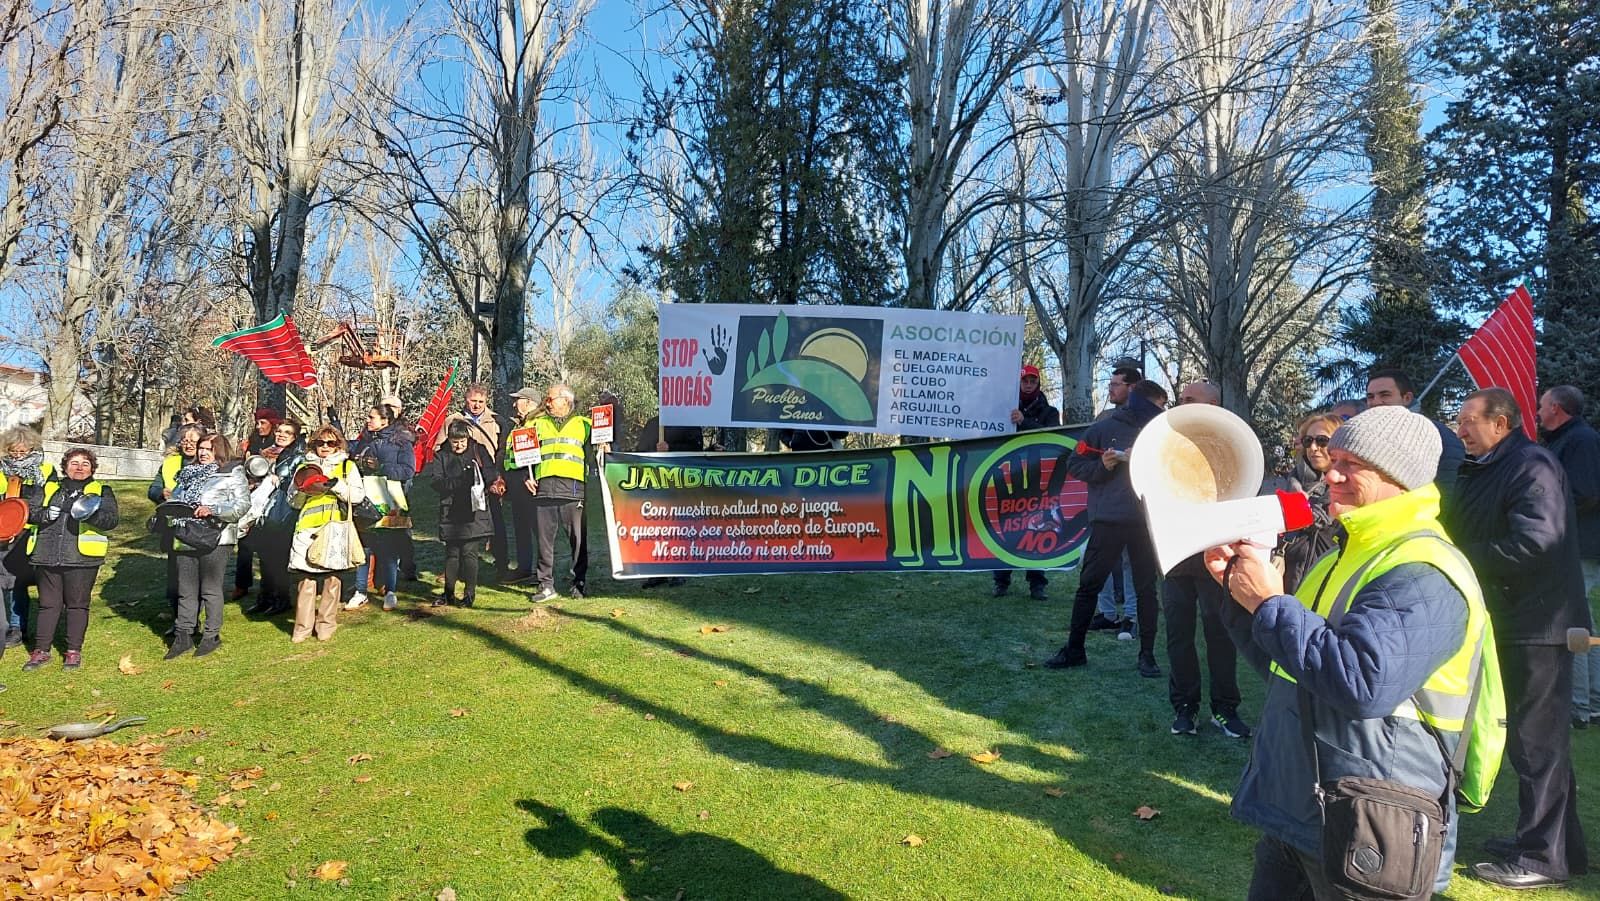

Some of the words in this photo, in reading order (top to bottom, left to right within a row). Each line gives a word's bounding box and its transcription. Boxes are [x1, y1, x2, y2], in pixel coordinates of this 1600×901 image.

[890, 324, 1017, 348] ASOCIACIÓN
[662, 338, 698, 368] STOP
[894, 349, 909, 360] EL
[912, 350, 973, 363] MADERAL
[893, 362, 988, 378] CUELGAMURES
[661, 370, 713, 407] BIOGÁS
[892, 375, 907, 385] EL
[911, 375, 947, 388] CUBO
[752, 387, 808, 405] Pueblos
[892, 388, 955, 401] VILLAMOR
[779, 404, 824, 420] Sanos
[890, 401, 961, 415] ARGUJILLO
[890, 414, 1005, 432] FUENTESPREADAS
[620, 466, 781, 490] JAMBRINA
[794, 464, 871, 487] DICE
[641, 501, 668, 517] Con
[669, 500, 720, 516] nuestra
[721, 499, 760, 516] salud
[761, 503, 778, 514] no
[780, 501, 798, 516] se
[800, 497, 844, 518] juega.
[1000, 491, 1059, 514] BIOGÁS
[630, 523, 697, 542] queremos
[699, 525, 721, 538] ser
[725, 519, 801, 537] estercolero
[804, 518, 822, 534] de
[824, 517, 880, 538] Europa.
[652, 540, 669, 557] Ni
[670, 546, 687, 557] en
[690, 541, 705, 556] tu
[706, 540, 752, 561] pueblo
[755, 540, 769, 556] ni
[771, 546, 788, 556] en
[790, 540, 805, 556] el
[806, 540, 832, 556] mío
[1016, 530, 1058, 554] NO
